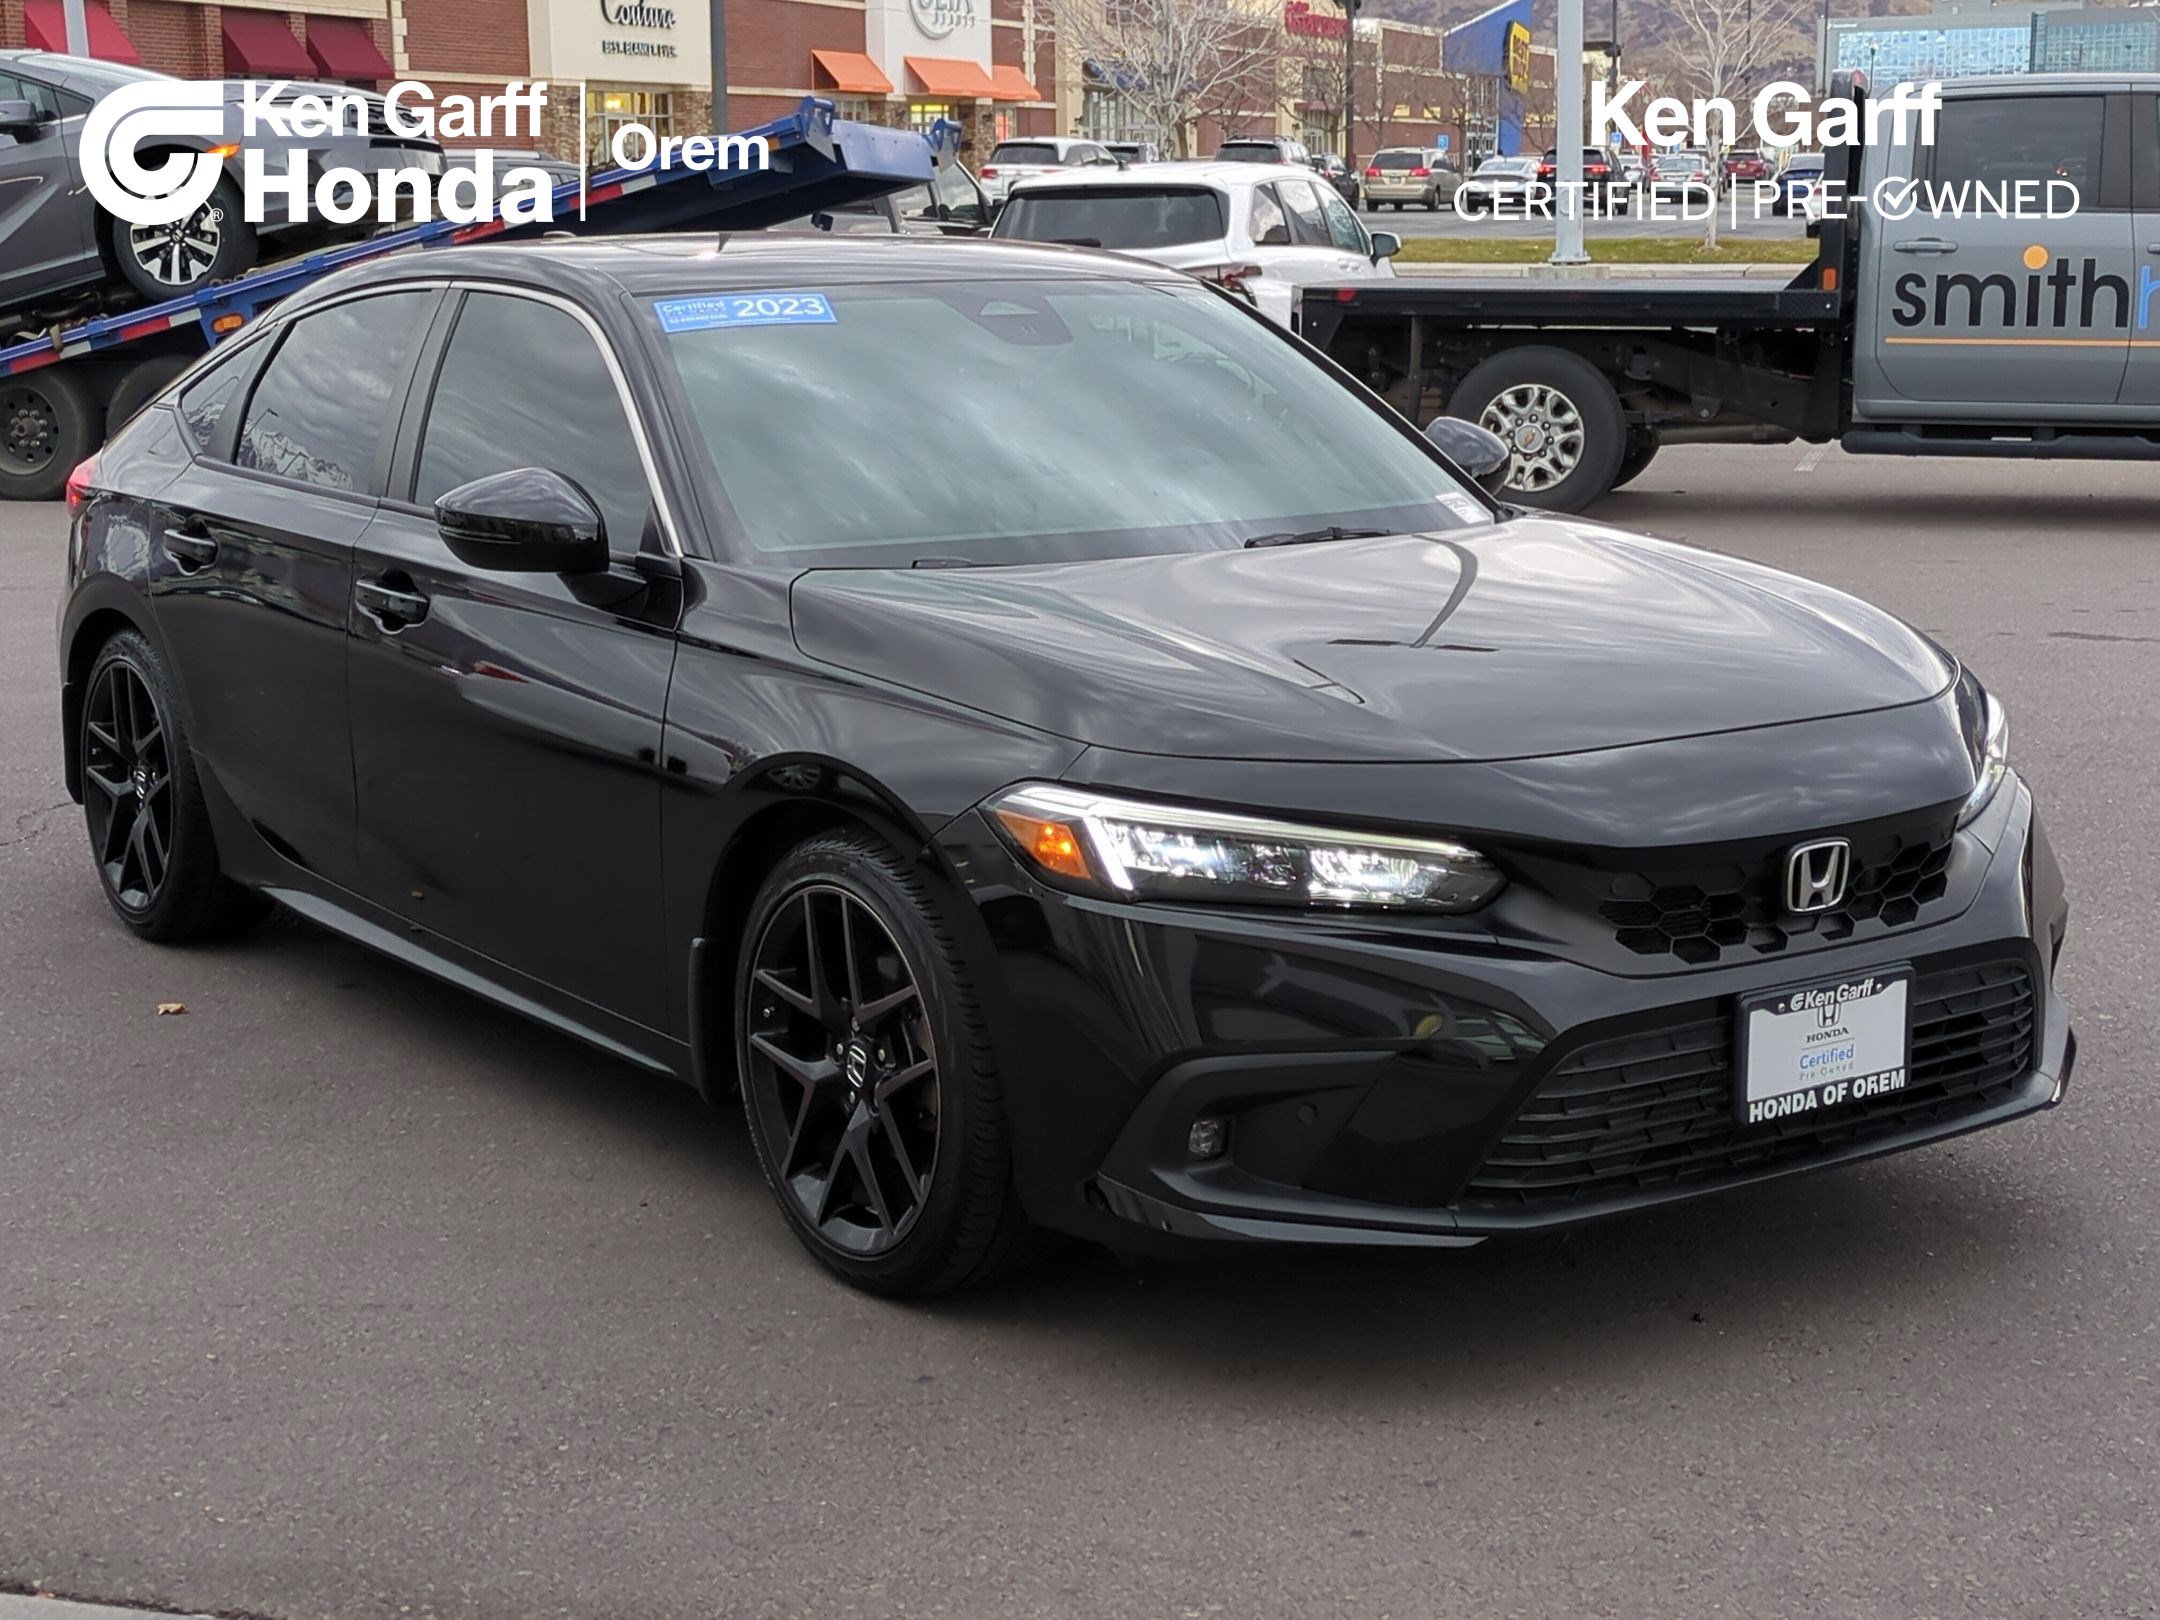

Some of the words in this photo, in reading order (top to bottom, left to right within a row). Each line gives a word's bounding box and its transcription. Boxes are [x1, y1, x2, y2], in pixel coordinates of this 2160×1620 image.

[733, 297, 826, 317] 2023
[1804, 989, 1835, 1010] Ken
[1836, 978, 1875, 1004] Garff
[1806, 1027, 1849, 1043] HONDA
[1800, 1044, 1855, 1070] Certified
[1749, 1090, 1818, 1124] HONDA
[1823, 1082, 1848, 1106] OF
[1852, 1069, 1906, 1099] OREM
